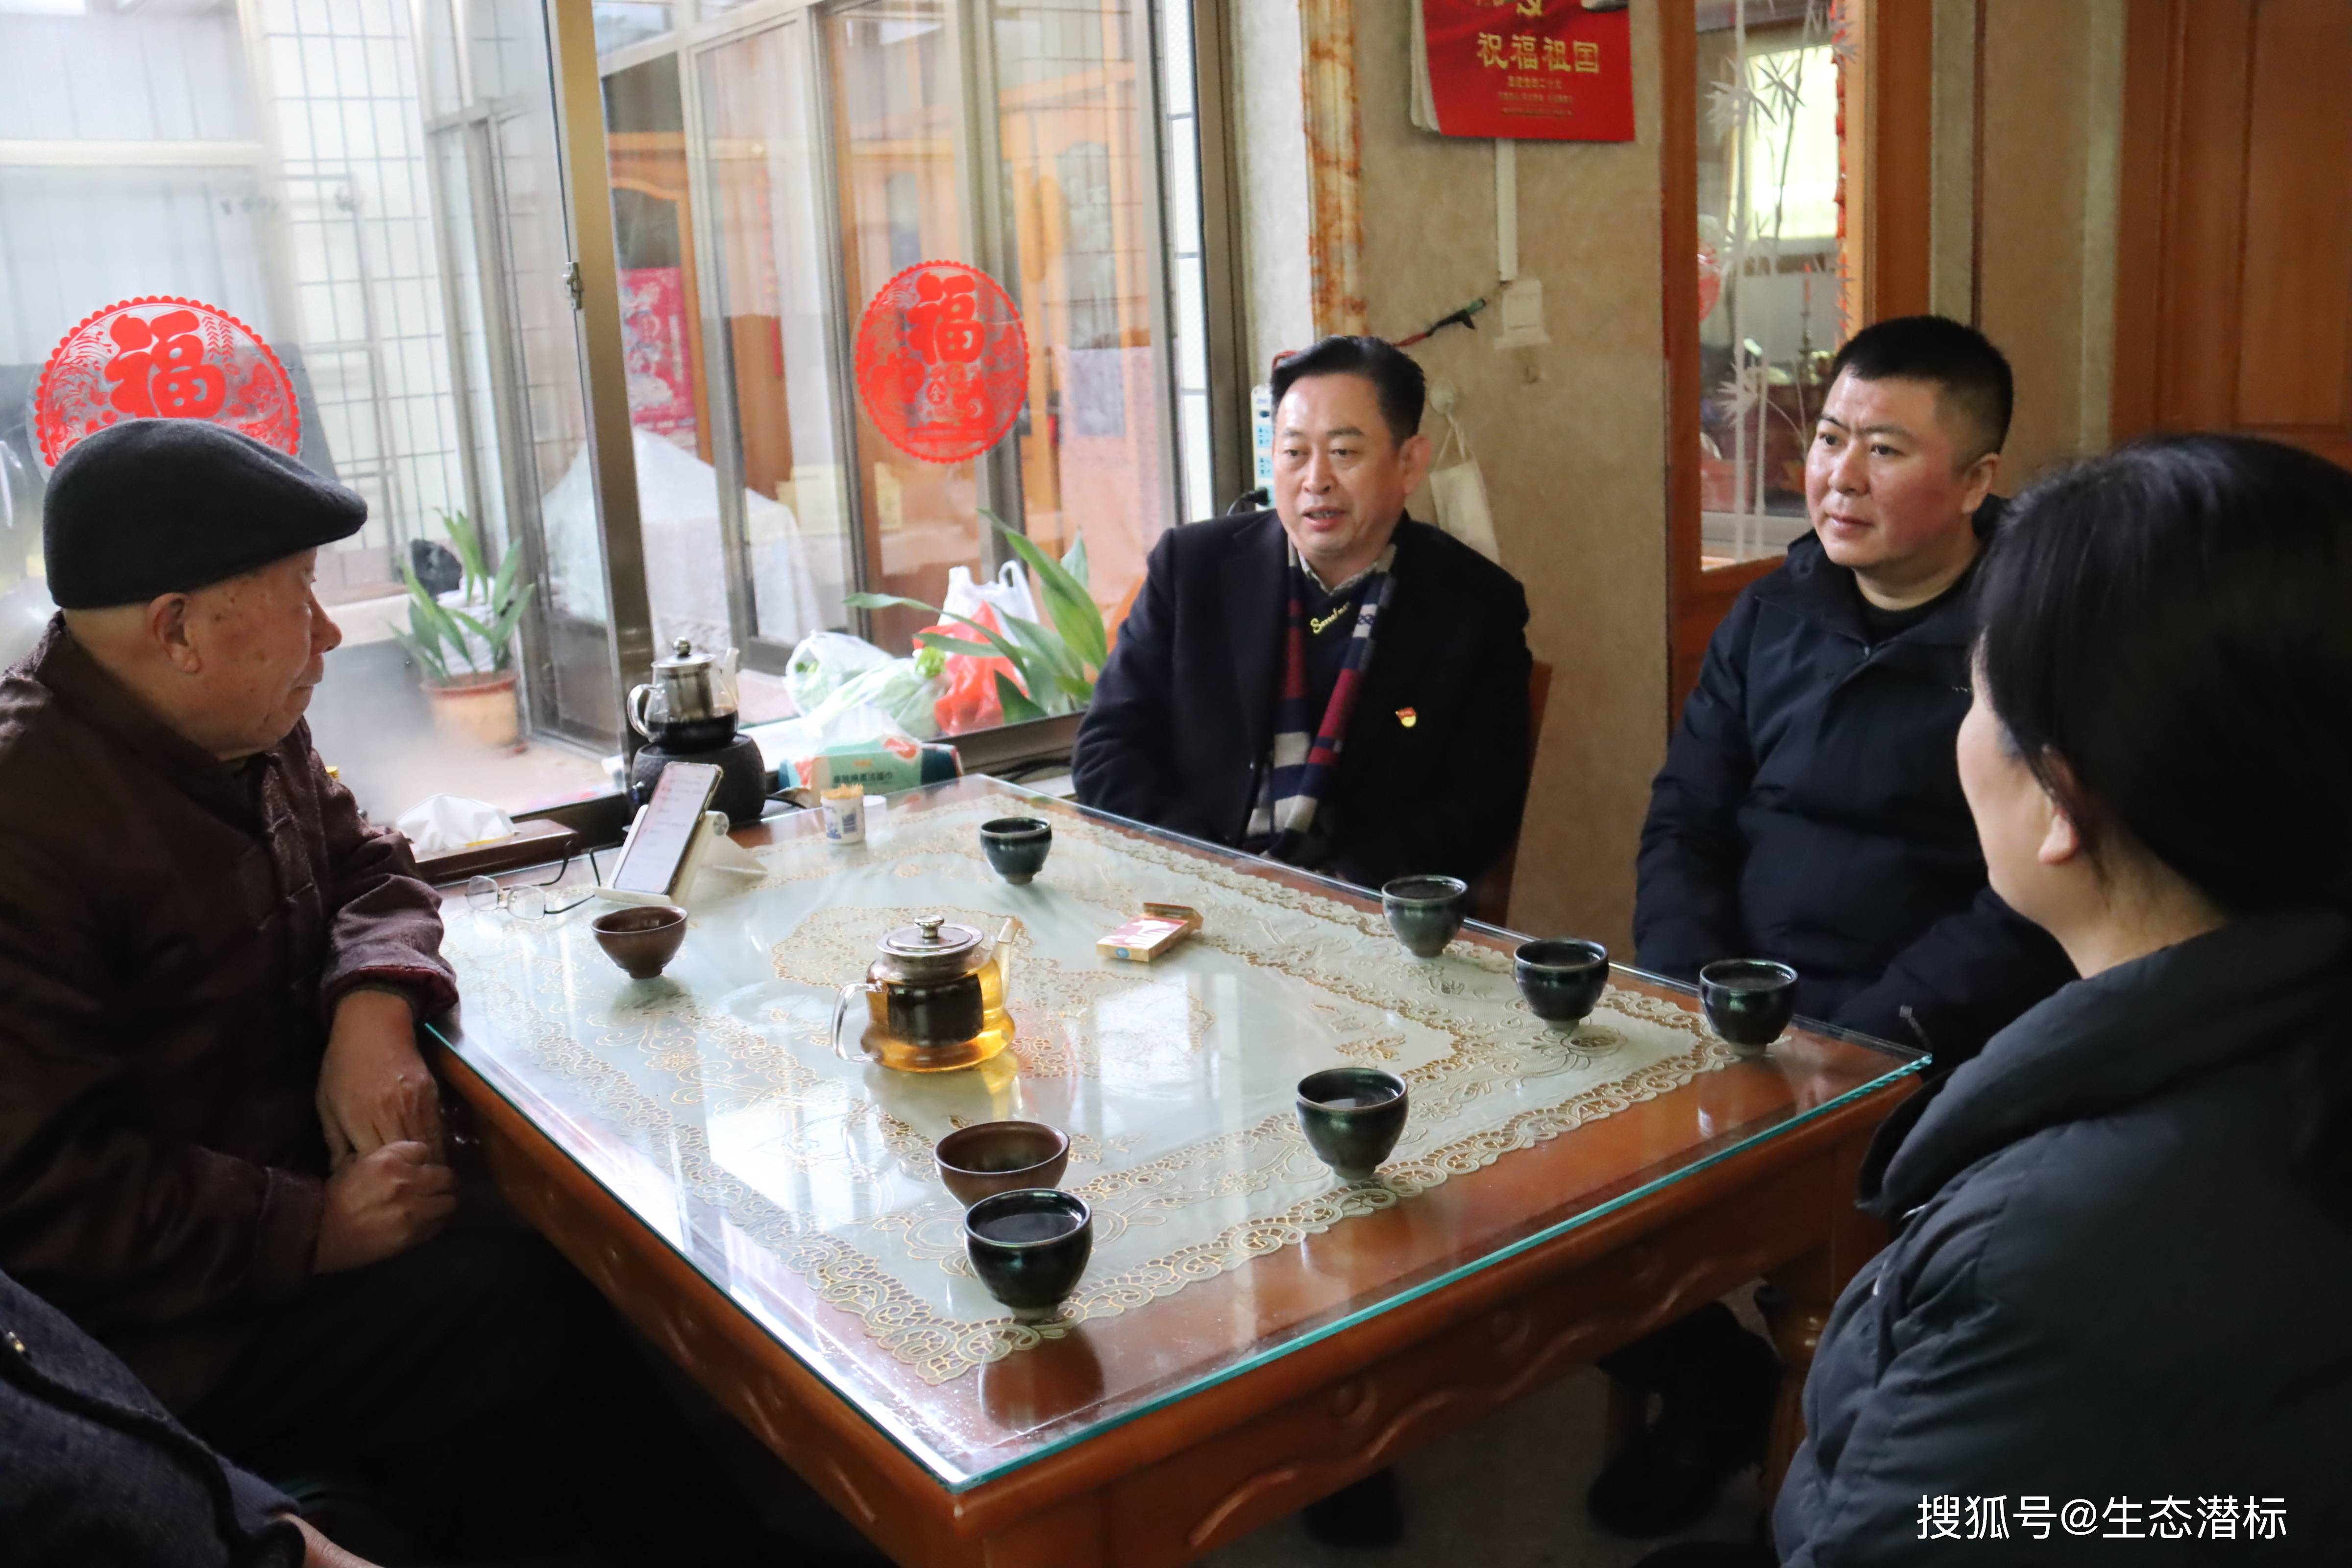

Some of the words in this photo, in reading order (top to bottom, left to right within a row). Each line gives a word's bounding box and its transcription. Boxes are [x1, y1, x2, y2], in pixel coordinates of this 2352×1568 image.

[1476, 32, 1600, 73] 祝福祖国
[104, 310, 226, 418] 福
[906, 272, 985, 365] 福
